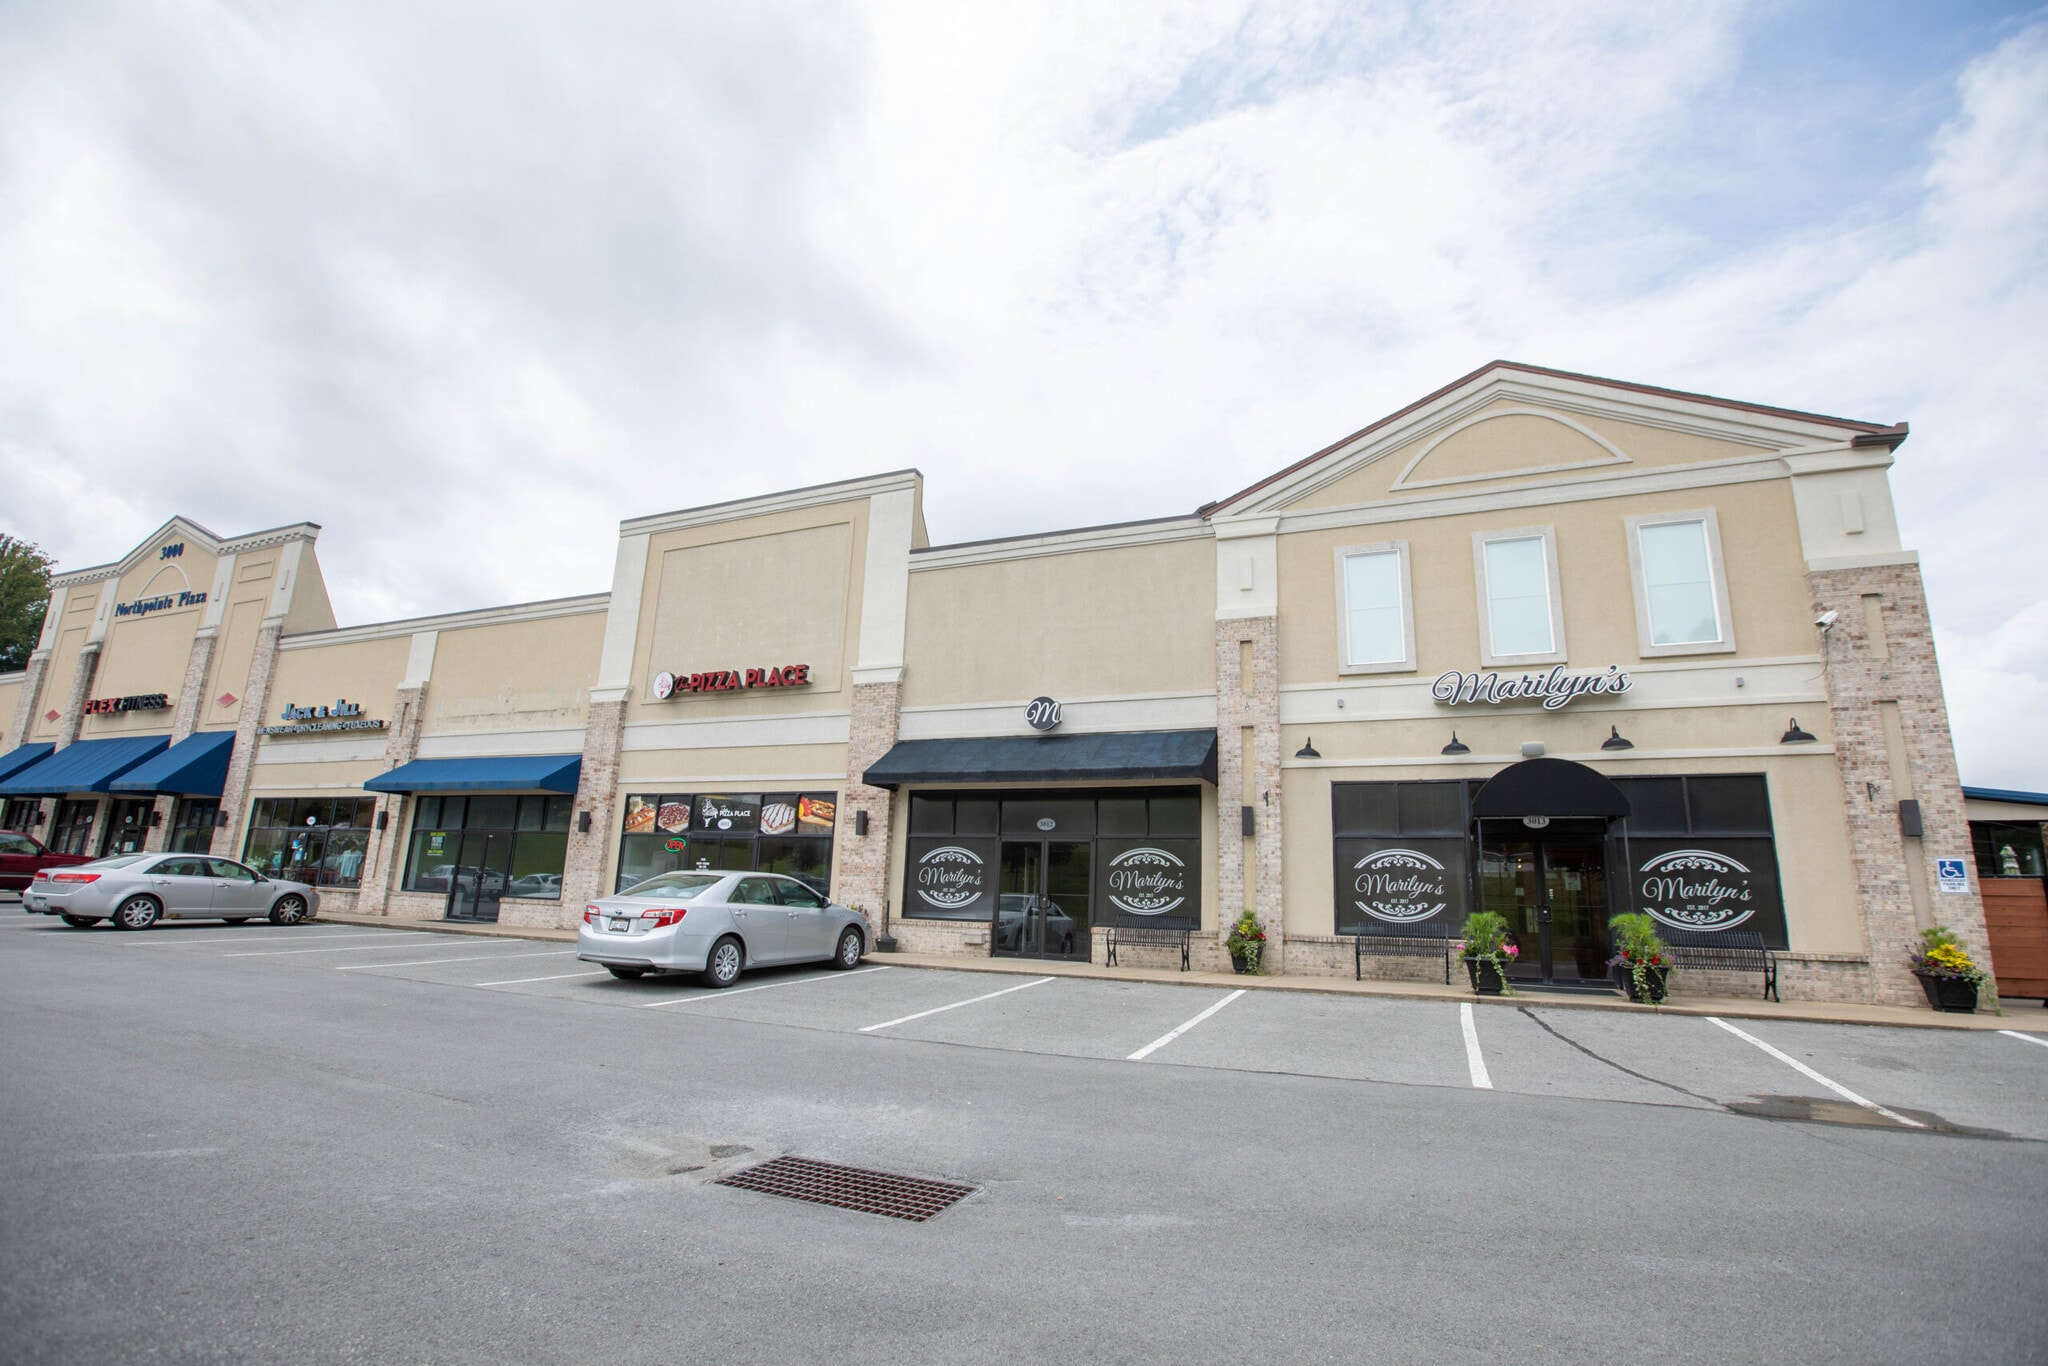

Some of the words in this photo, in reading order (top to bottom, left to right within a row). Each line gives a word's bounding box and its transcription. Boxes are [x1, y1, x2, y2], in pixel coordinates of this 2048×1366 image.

[160, 543, 184, 560] 3000
[114, 597, 173, 617] Northpointe
[178, 591, 207, 607] Plaza
[689, 671, 739, 692] PIZZA
[745, 664, 807, 688] PLACE
[1431, 663, 1633, 710] Marilyn's
[83, 698, 118, 715] FLEX
[121, 693, 168, 711] FITNESS
[317, 706, 328, 718] &
[666, 839, 685, 850] OPEN
[918, 866, 982, 888] Marilyn's
[1109, 870, 1184, 893] Marilyn's
[1355, 873, 1445, 899] Marilyn's
[1642, 877, 1752, 905] Marilyn's
